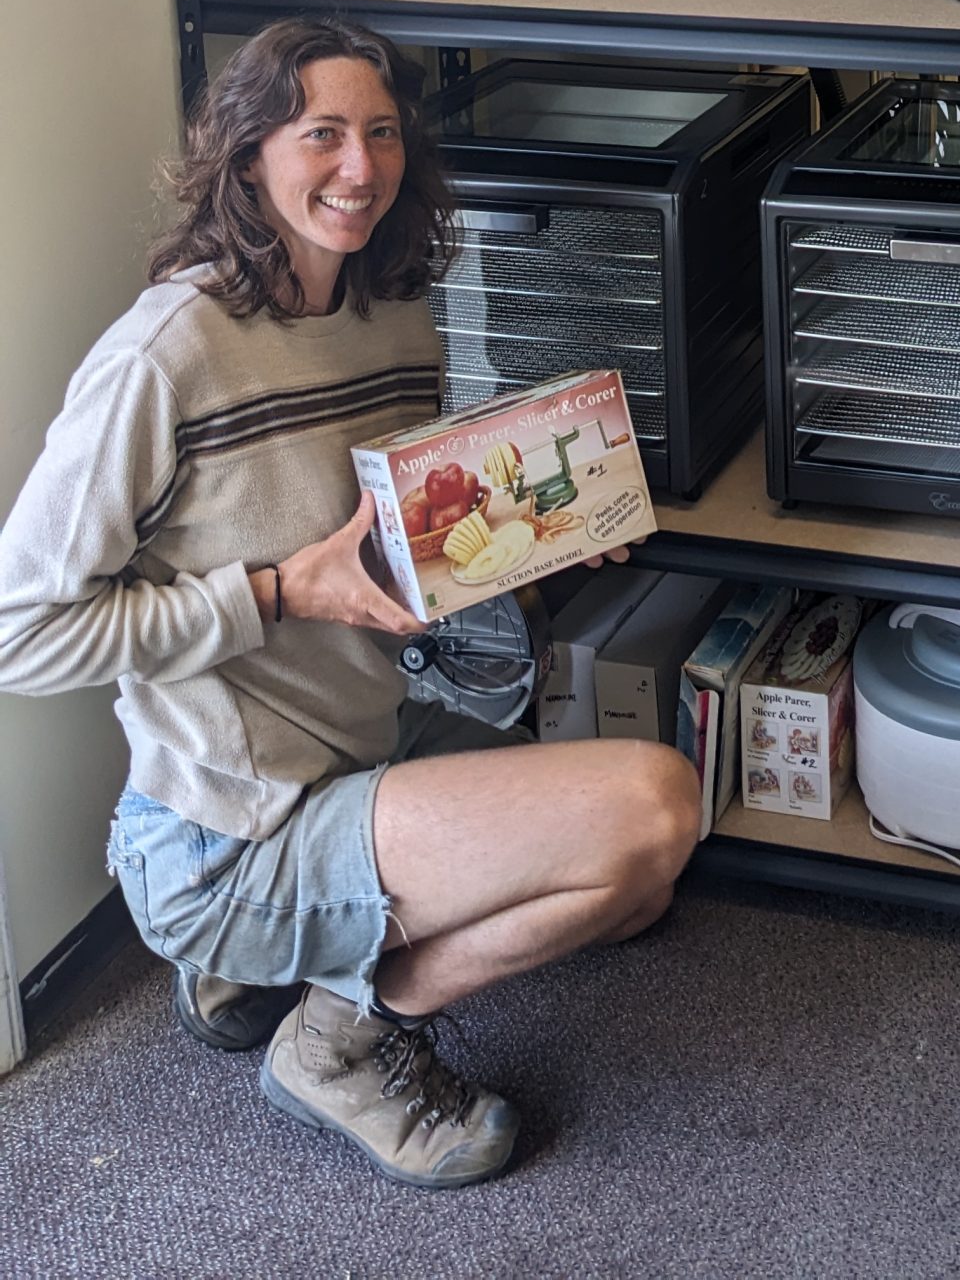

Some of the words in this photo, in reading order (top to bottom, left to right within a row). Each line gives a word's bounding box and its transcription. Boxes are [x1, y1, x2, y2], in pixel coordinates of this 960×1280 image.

[517, 406, 559, 431] Slicer
[559, 400, 574, 417] &
[575, 386, 617, 409] Corer
[587, 463, 608, 477] #1
[613, 491, 630, 507] cores
[594, 521, 606, 533] and
[605, 508, 622, 524] slices
[622, 501, 629, 510] in
[628, 493, 640, 504] one
[601, 525, 616, 538] easy
[615, 502, 642, 527] operation
[497, 569, 533, 588] SUCTION
[534, 559, 555, 574] BASE
[554, 548, 585, 565] MODEL
[756, 691, 783, 704] Apple
[784, 695, 812, 707] Parer,
[752, 706, 777, 718] Slicer
[778, 710, 787, 720] &
[789, 712, 817, 723] Corer
[801, 757, 818, 769] #2
